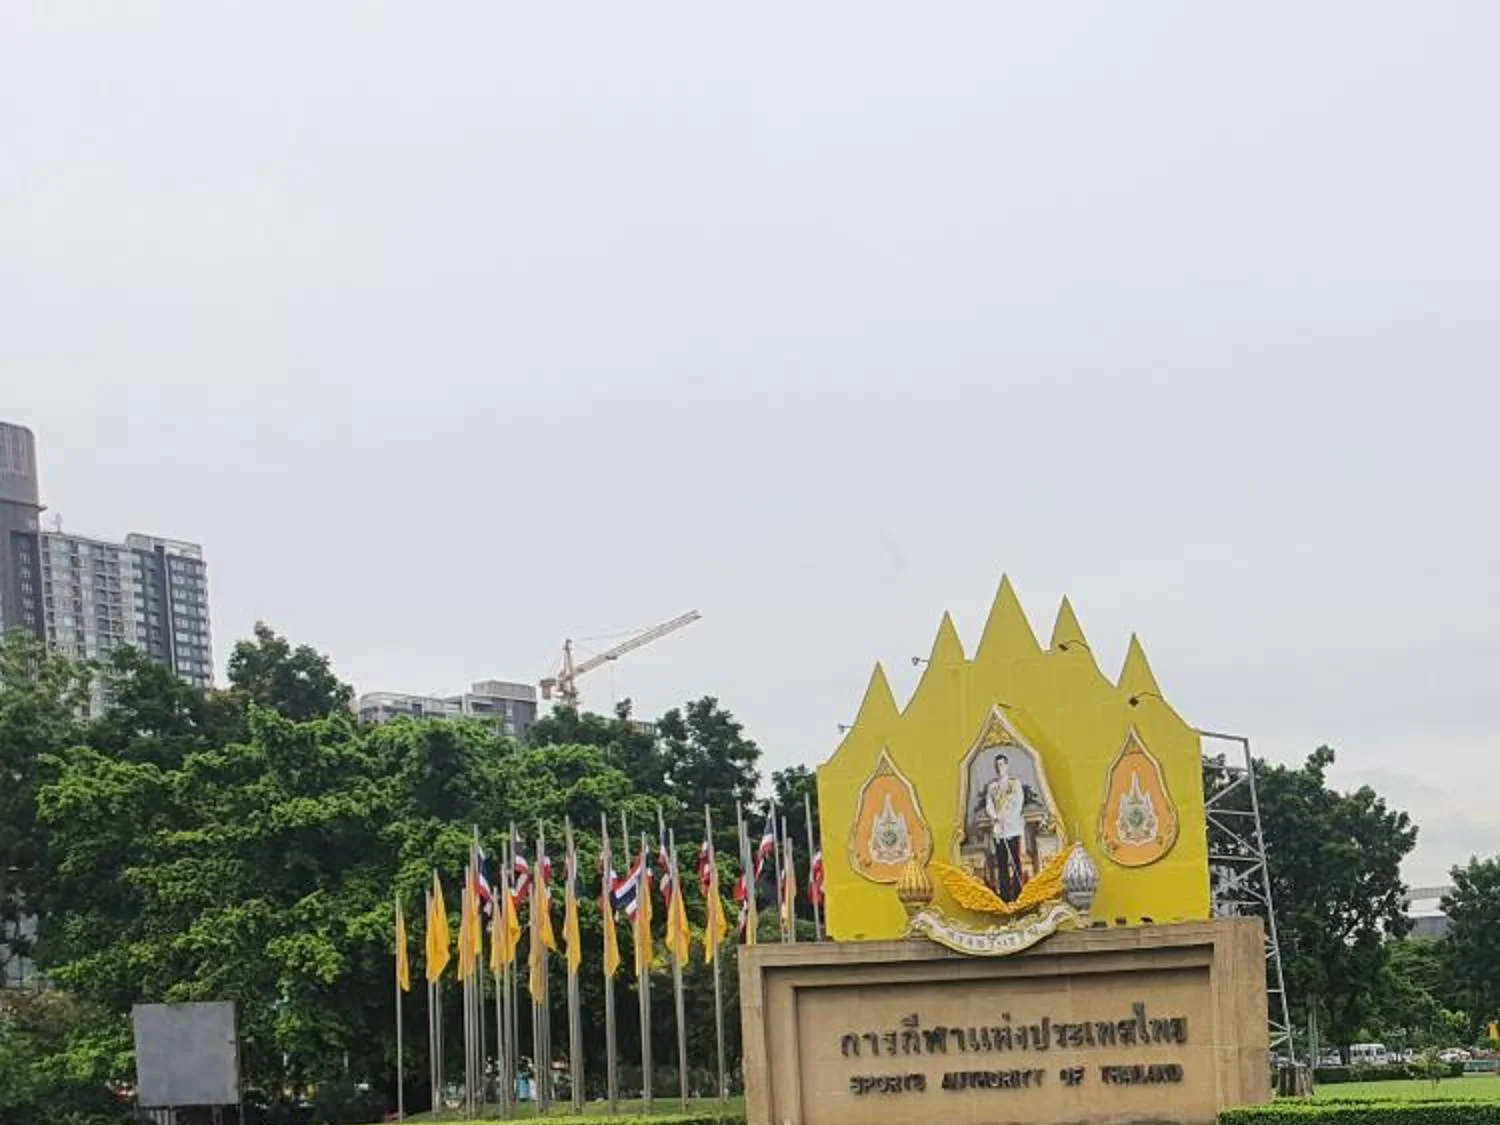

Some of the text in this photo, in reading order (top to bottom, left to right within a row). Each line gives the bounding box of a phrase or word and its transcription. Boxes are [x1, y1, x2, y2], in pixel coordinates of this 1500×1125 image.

[841, 1001, 1188, 1056] การกีฬาแห่งประเทศไทย
[850, 1063, 1184, 1095] SPORTS AUTHORITY OF THAILAND
